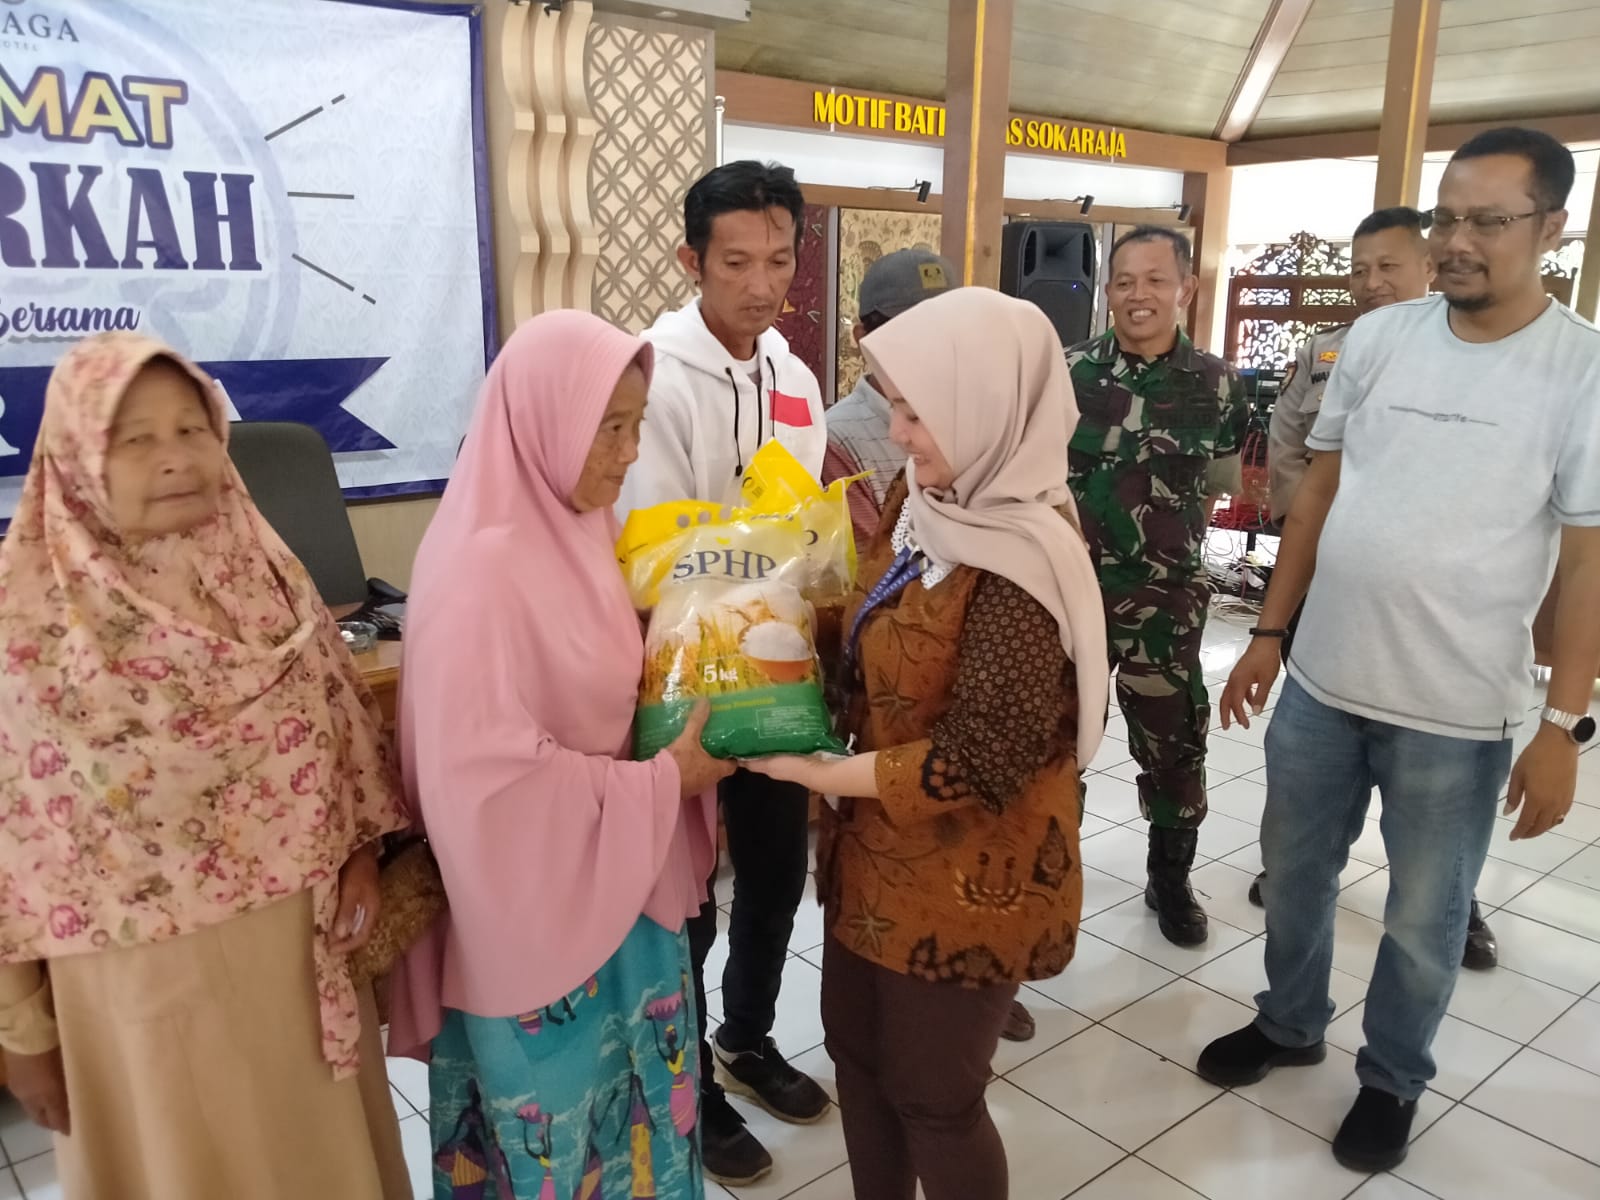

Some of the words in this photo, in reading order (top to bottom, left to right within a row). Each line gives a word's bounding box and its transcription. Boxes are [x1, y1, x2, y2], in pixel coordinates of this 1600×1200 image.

[814, 90, 892, 129] MOTIF
[894, 101, 946, 137] BATI
[1026, 120, 1127, 158] SOKARAJA
[673, 549, 777, 579] SPHP
[703, 663, 718, 683] 5
